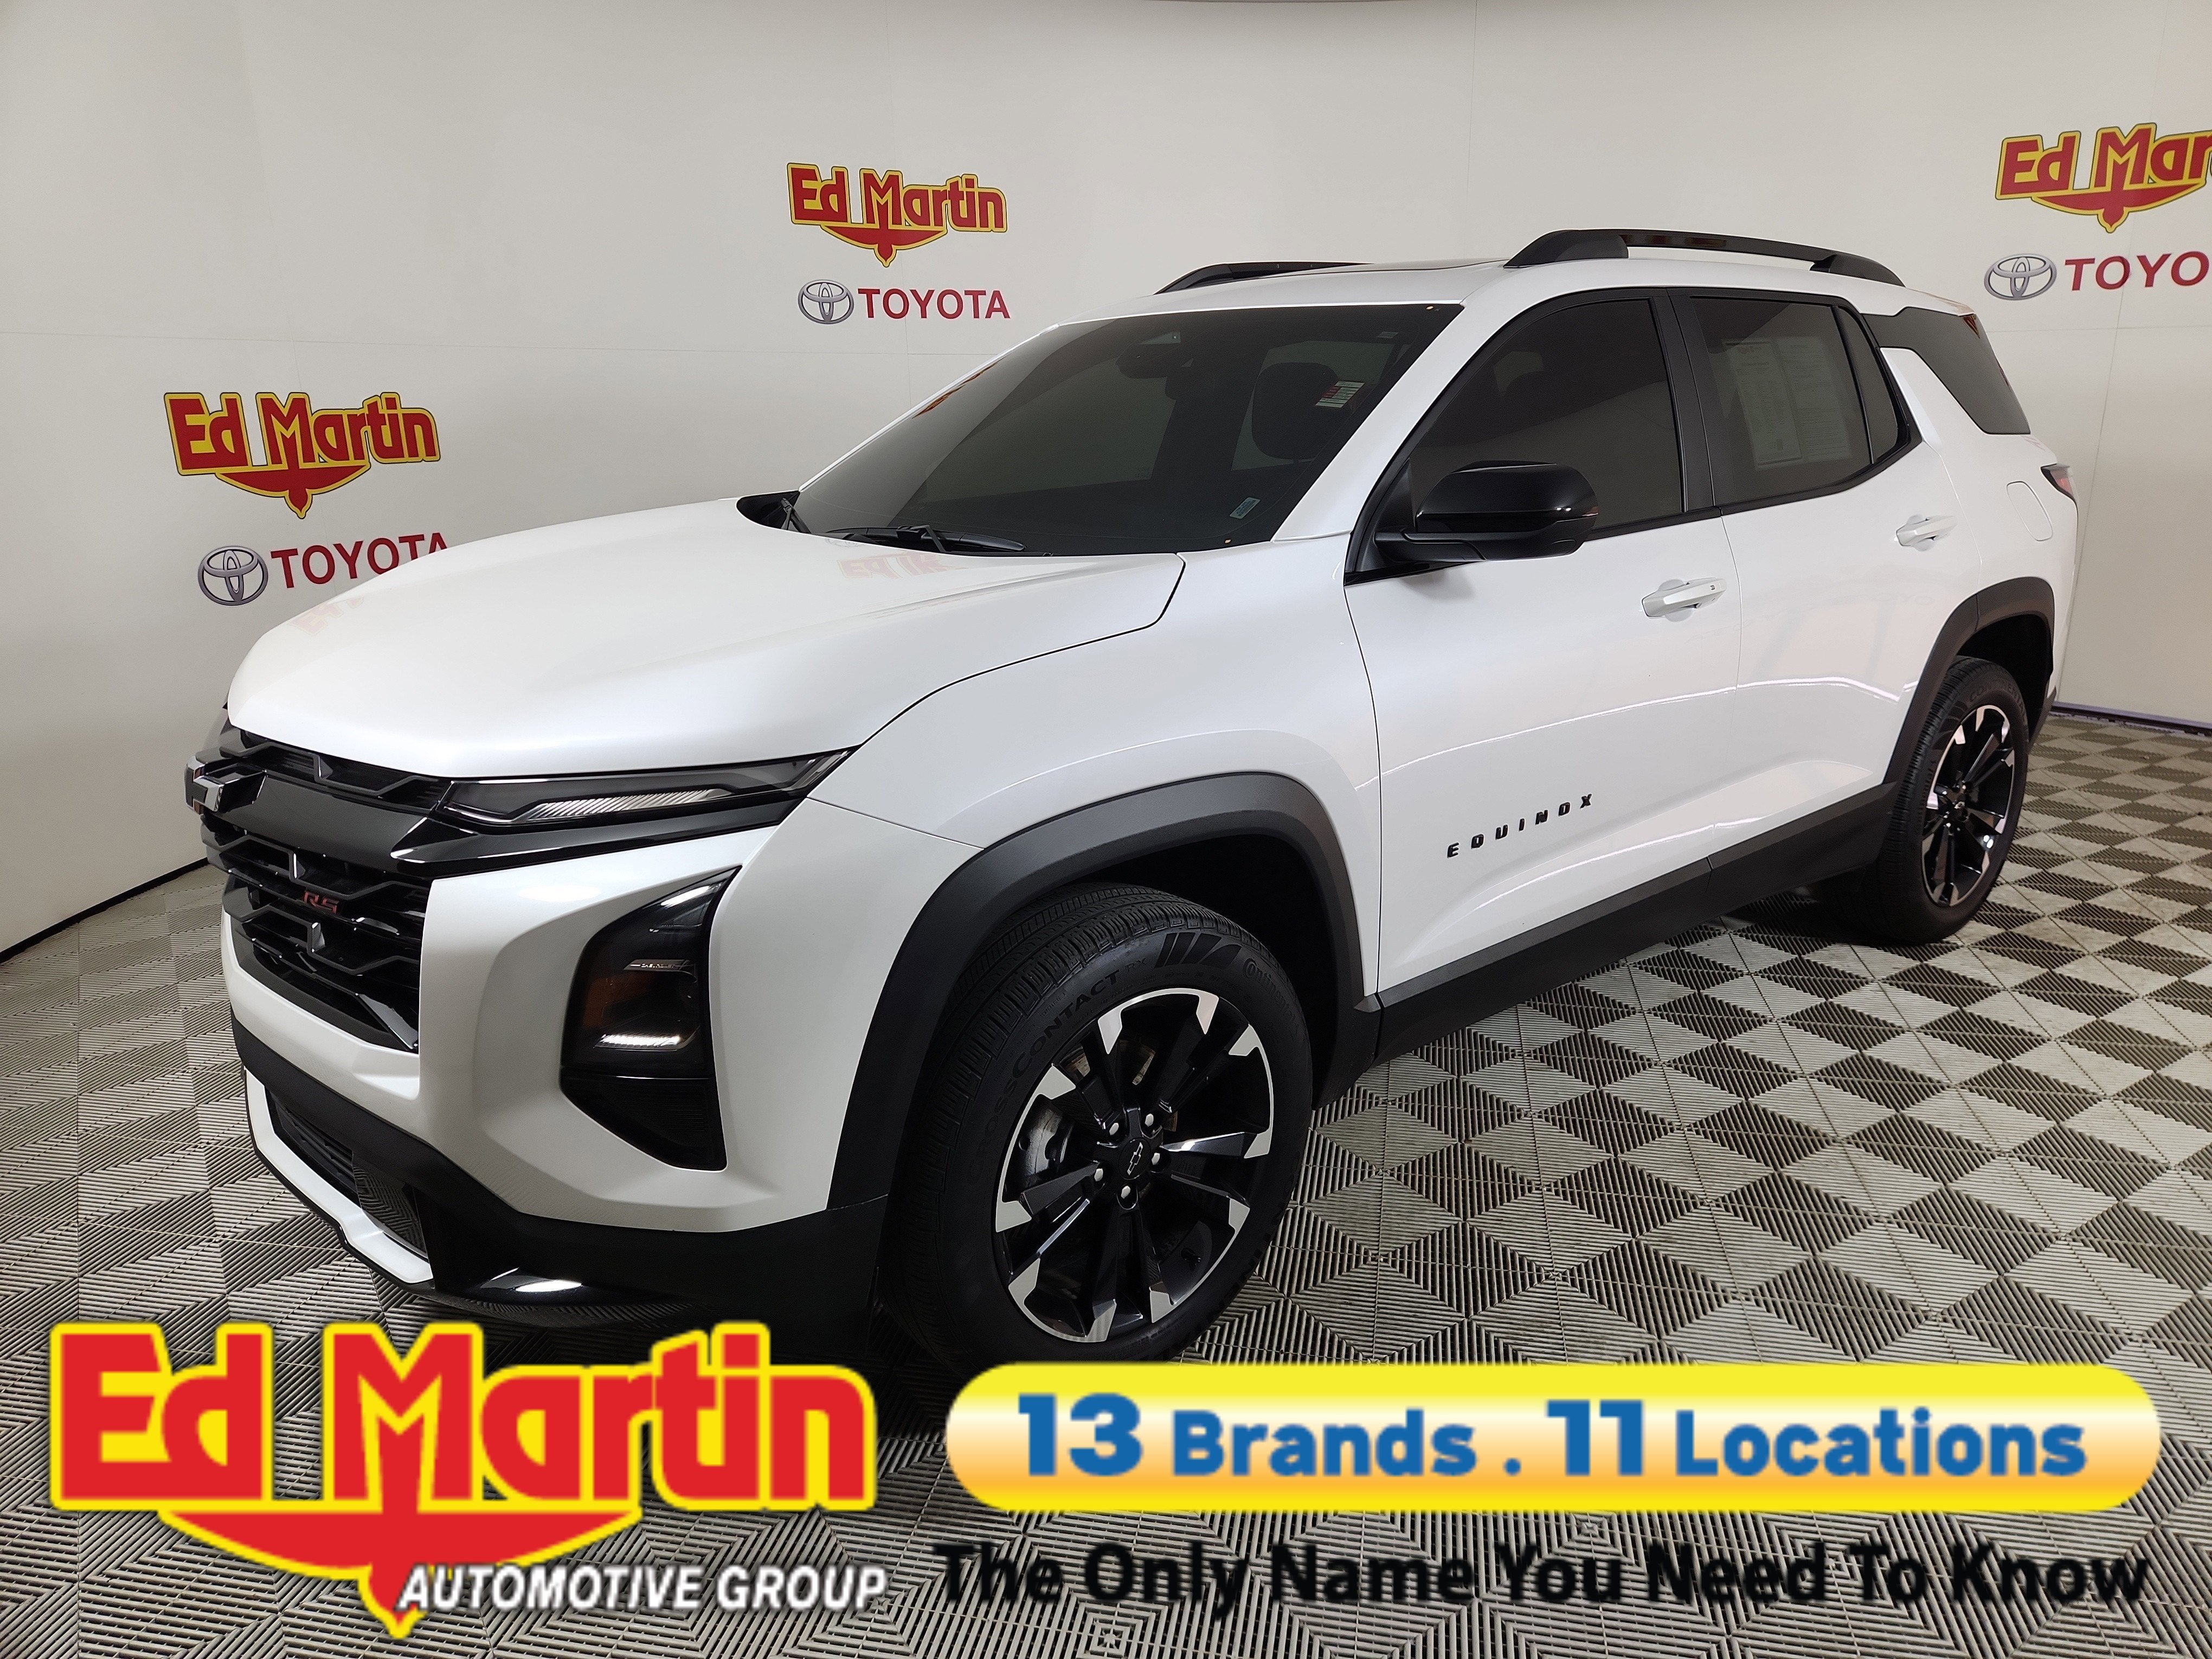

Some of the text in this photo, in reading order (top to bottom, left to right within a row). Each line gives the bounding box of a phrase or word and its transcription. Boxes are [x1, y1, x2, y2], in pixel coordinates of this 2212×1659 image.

[1996, 123, 2212, 200] Ed Mar
[787, 163, 1007, 232] Ed Martin
[858, 288, 1011, 319] TOYOTA
[164, 393, 441, 475] Ed Martin
[1446, 794, 1592, 858] EQUINOX
[304, 891, 339, 914] RS
